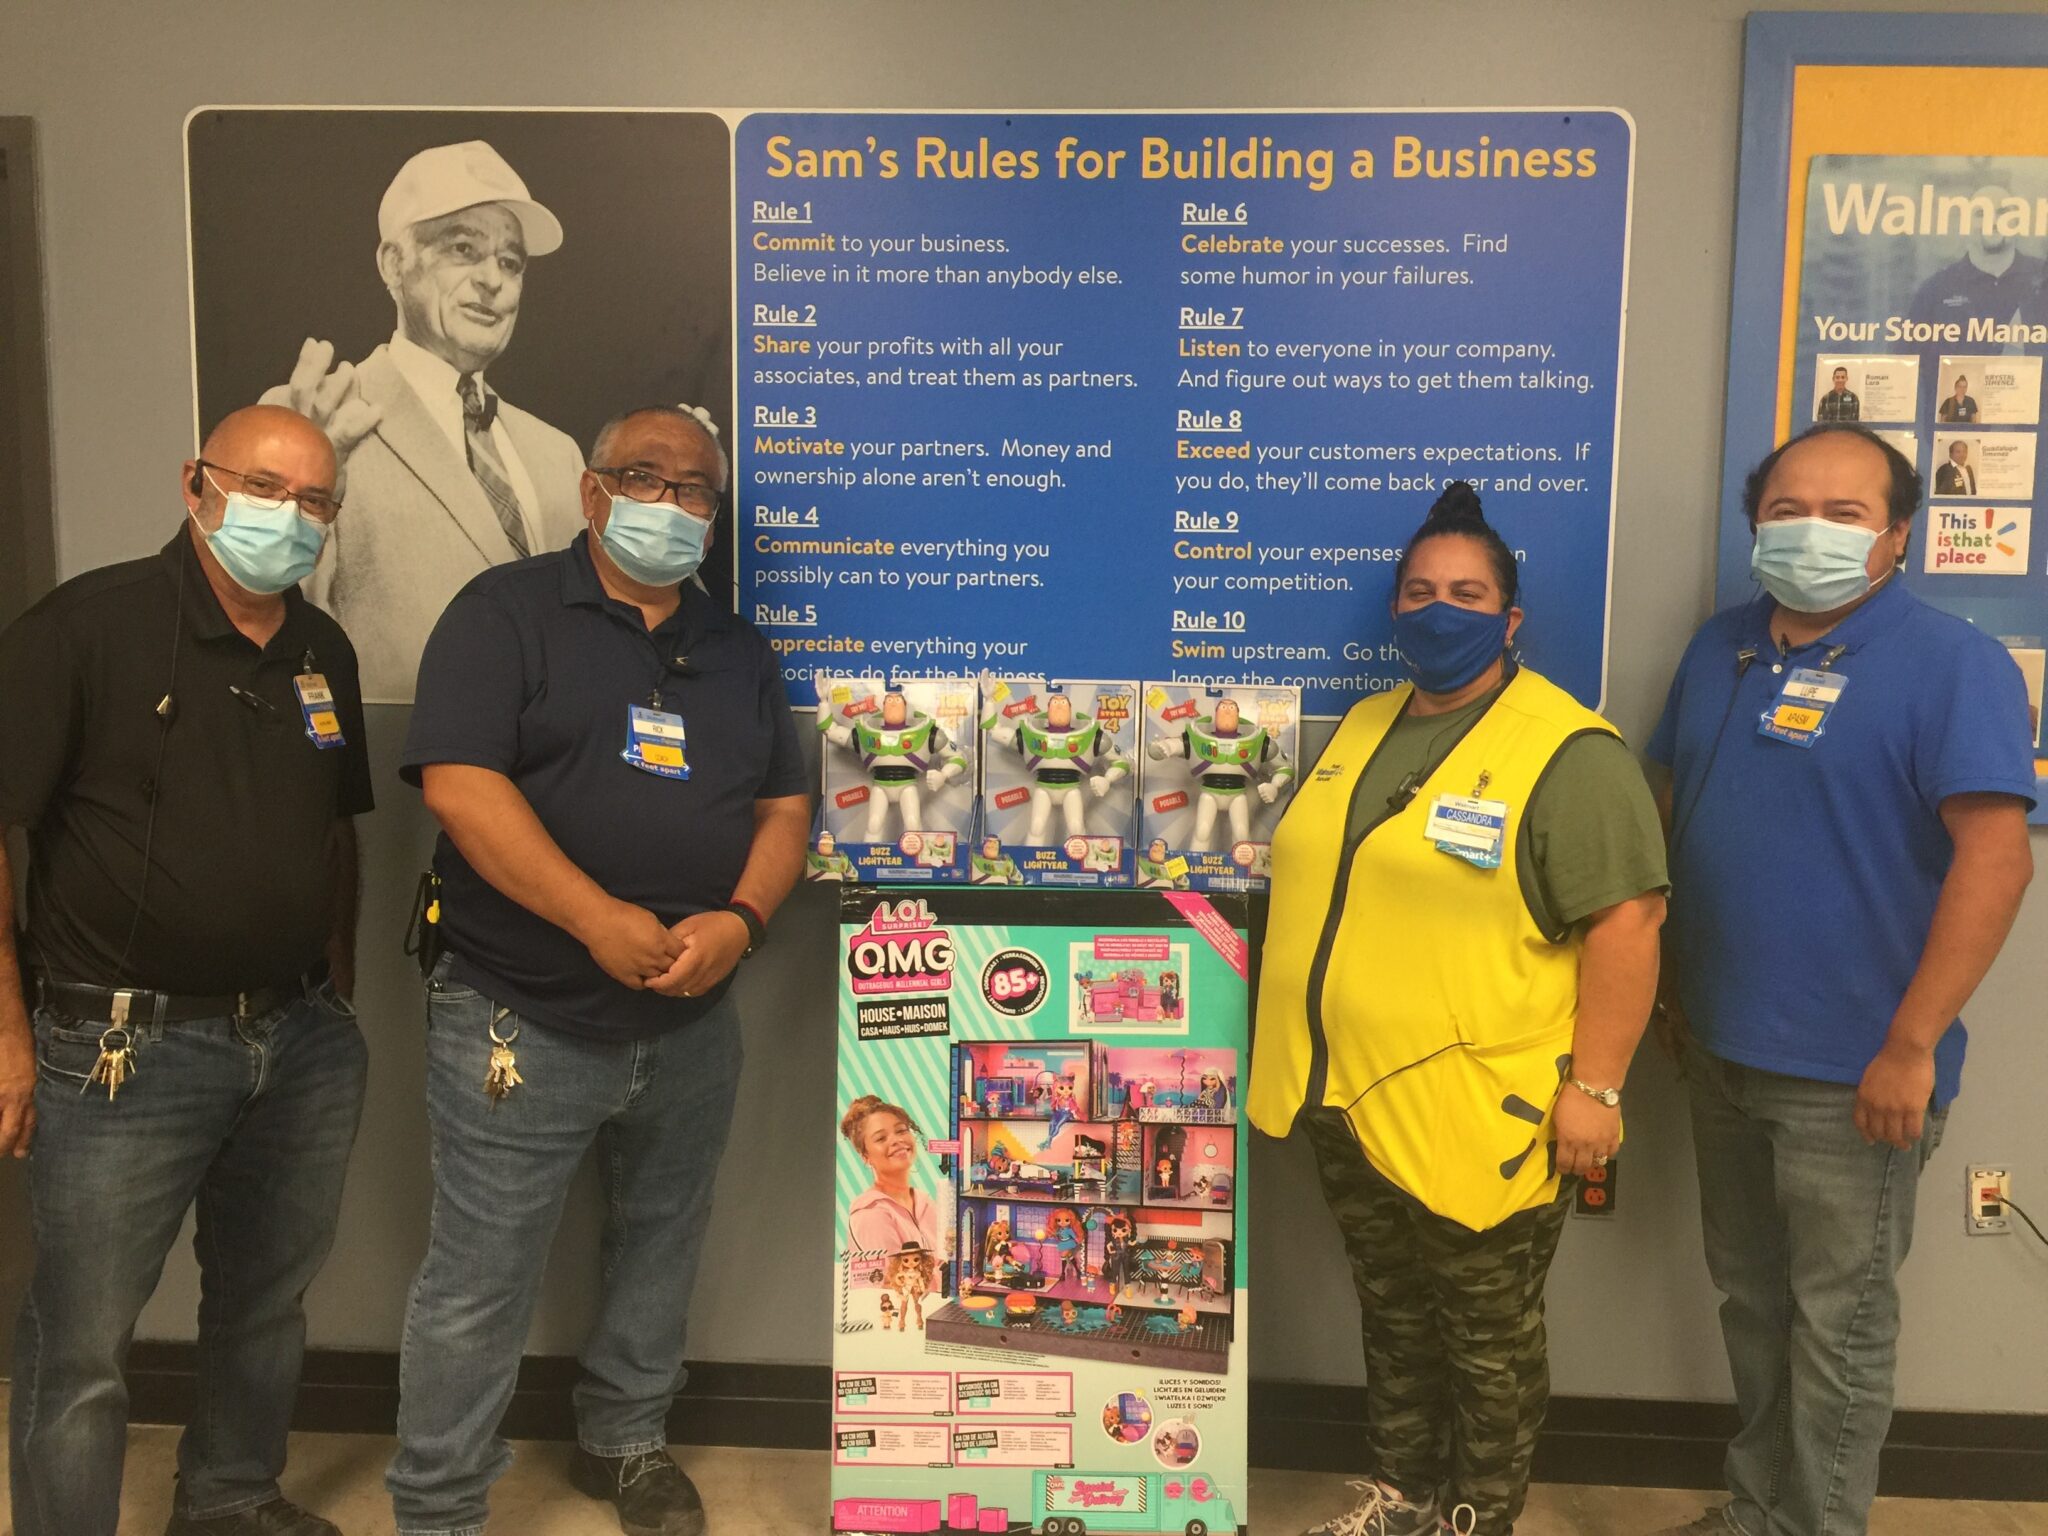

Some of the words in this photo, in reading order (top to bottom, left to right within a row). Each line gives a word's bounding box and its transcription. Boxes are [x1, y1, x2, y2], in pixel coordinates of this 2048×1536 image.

[916, 136, 1040, 179] Rules
[1055, 136, 1126, 179] for
[1141, 136, 1334, 191] Building
[1350, 149, 1374, 179] a
[1393, 135, 1597, 178] Business
[753, 201, 798, 220] Rule
[803, 201, 812, 220] 1
[1182, 203, 1228, 222] Rule
[1235, 203, 1248, 222] 6
[753, 232, 836, 251] Commit
[842, 235, 862, 252] to
[869, 236, 915, 257] your
[921, 234, 1010, 253] business.
[1181, 234, 1284, 254] Celebrate
[1290, 238, 1338, 258] your
[1343, 237, 1450, 254] successes.
[1463, 233, 1508, 254] Find
[754, 263, 826, 283] Believe
[833, 265, 849, 282] in
[856, 265, 870, 282] it
[877, 270, 929, 284] more
[935, 266, 979, 284] than
[986, 266, 1072, 289] anybody
[1078, 266, 1122, 285] else.
[1181, 269, 1235, 284] some
[1242, 267, 1309, 284] humor
[1316, 267, 1333, 284] in
[1340, 270, 1387, 290] your
[1393, 265, 1474, 286] failures.
[754, 305, 799, 322] Rule
[805, 305, 816, 322] 2
[1180, 308, 1225, 327] Rule
[1231, 308, 1243, 327] 7
[1814, 316, 1879, 341] Your
[1885, 317, 1960, 342] Store
[754, 335, 811, 353] Share
[817, 340, 862, 358] your
[868, 336, 934, 359] profits
[940, 338, 983, 356] with
[989, 338, 1011, 356] all
[1017, 341, 1063, 360] your
[1179, 338, 1241, 357] Listen
[1247, 340, 1268, 358] to
[1275, 343, 1372, 362] everyone
[1378, 340, 1395, 357] in
[1402, 343, 1449, 362] your
[1456, 343, 1556, 363] company.
[754, 366, 860, 388] associates,
[866, 367, 902, 386] and
[908, 369, 957, 386] treat
[964, 369, 1016, 387] them
[1022, 373, 1042, 387] as
[1049, 370, 1138, 391] partners.
[1178, 370, 1218, 389] And
[1224, 369, 1286, 392] figure
[1292, 371, 1326, 389] out
[1334, 373, 1382, 393] ways
[1389, 372, 1410, 389] to
[1417, 372, 1452, 393] get
[1458, 370, 1512, 389] them
[1519, 370, 1594, 393] talking.
[755, 406, 799, 424] Rule
[805, 407, 816, 424] 3
[1177, 410, 1223, 429] Rule
[1228, 411, 1242, 429] 8
[755, 437, 845, 455] Motivate
[851, 441, 895, 460] your
[901, 438, 990, 460] partners.
[1001, 439, 1070, 461] Money
[1076, 440, 1111, 458] and
[1177, 440, 1250, 459] Exceed
[1256, 444, 1303, 464] your
[1308, 444, 1416, 461] customers
[1423, 443, 1562, 465] expectations.
[1575, 442, 1591, 461] If
[755, 469, 856, 490] ownership
[862, 468, 916, 486] alone
[986, 472, 1066, 491] enough.
[1175, 475, 1211, 494] you
[1218, 472, 1250, 492] do,
[1325, 476, 1381, 492] come
[1388, 472, 1436, 491] back
[1442, 475, 1488, 491] oer
[1494, 474, 1533, 492] and
[1538, 476, 1589, 492] over.
[755, 506, 800, 524] Rule
[804, 506, 819, 524] 4
[1174, 511, 1221, 530] Rule
[1226, 512, 1238, 530] 9
[1940, 513, 1976, 528] This
[755, 536, 895, 555] Communicate
[900, 538, 1007, 562] everything
[1013, 541, 1050, 562] you
[1174, 542, 1252, 560] Control
[1258, 546, 1304, 566] your
[1310, 546, 1403, 566] expenses
[1936, 549, 1986, 567] place
[755, 567, 833, 588] possibly
[839, 571, 872, 585] can
[879, 569, 899, 585] to
[906, 570, 951, 590] your
[956, 569, 1044, 590] partners.
[1173, 575, 1219, 595] your
[1224, 573, 1353, 595] competition.
[756, 605, 800, 622] Rule
[804, 606, 816, 622] 5
[1172, 611, 1218, 629] Rule
[1223, 611, 1245, 629] 10
[770, 634, 864, 656] ppreciate
[871, 636, 976, 660] everything
[983, 641, 1028, 660] your
[1172, 641, 1225, 659] Swim
[1232, 643, 1330, 664] upstream.
[1343, 643, 1374, 661] Go
[1381, 643, 1399, 661] th
[781, 664, 853, 680] ocites
[860, 664, 884, 680] do
[890, 665, 921, 679] for
[925, 666, 958, 679] the
[964, 666, 1051, 686] bsiness.
[1172, 669, 1236, 686] Ignore
[1242, 671, 1275, 686] the
[1282, 672, 1411, 691] conventiona
[1097, 694, 1132, 710] TOY
[1104, 718, 1120, 734] 4
[1446, 808, 1492, 826] CASSANDRA
[995, 967, 1038, 996] 85+
[857, 1504, 908, 1516] ATTENTION
